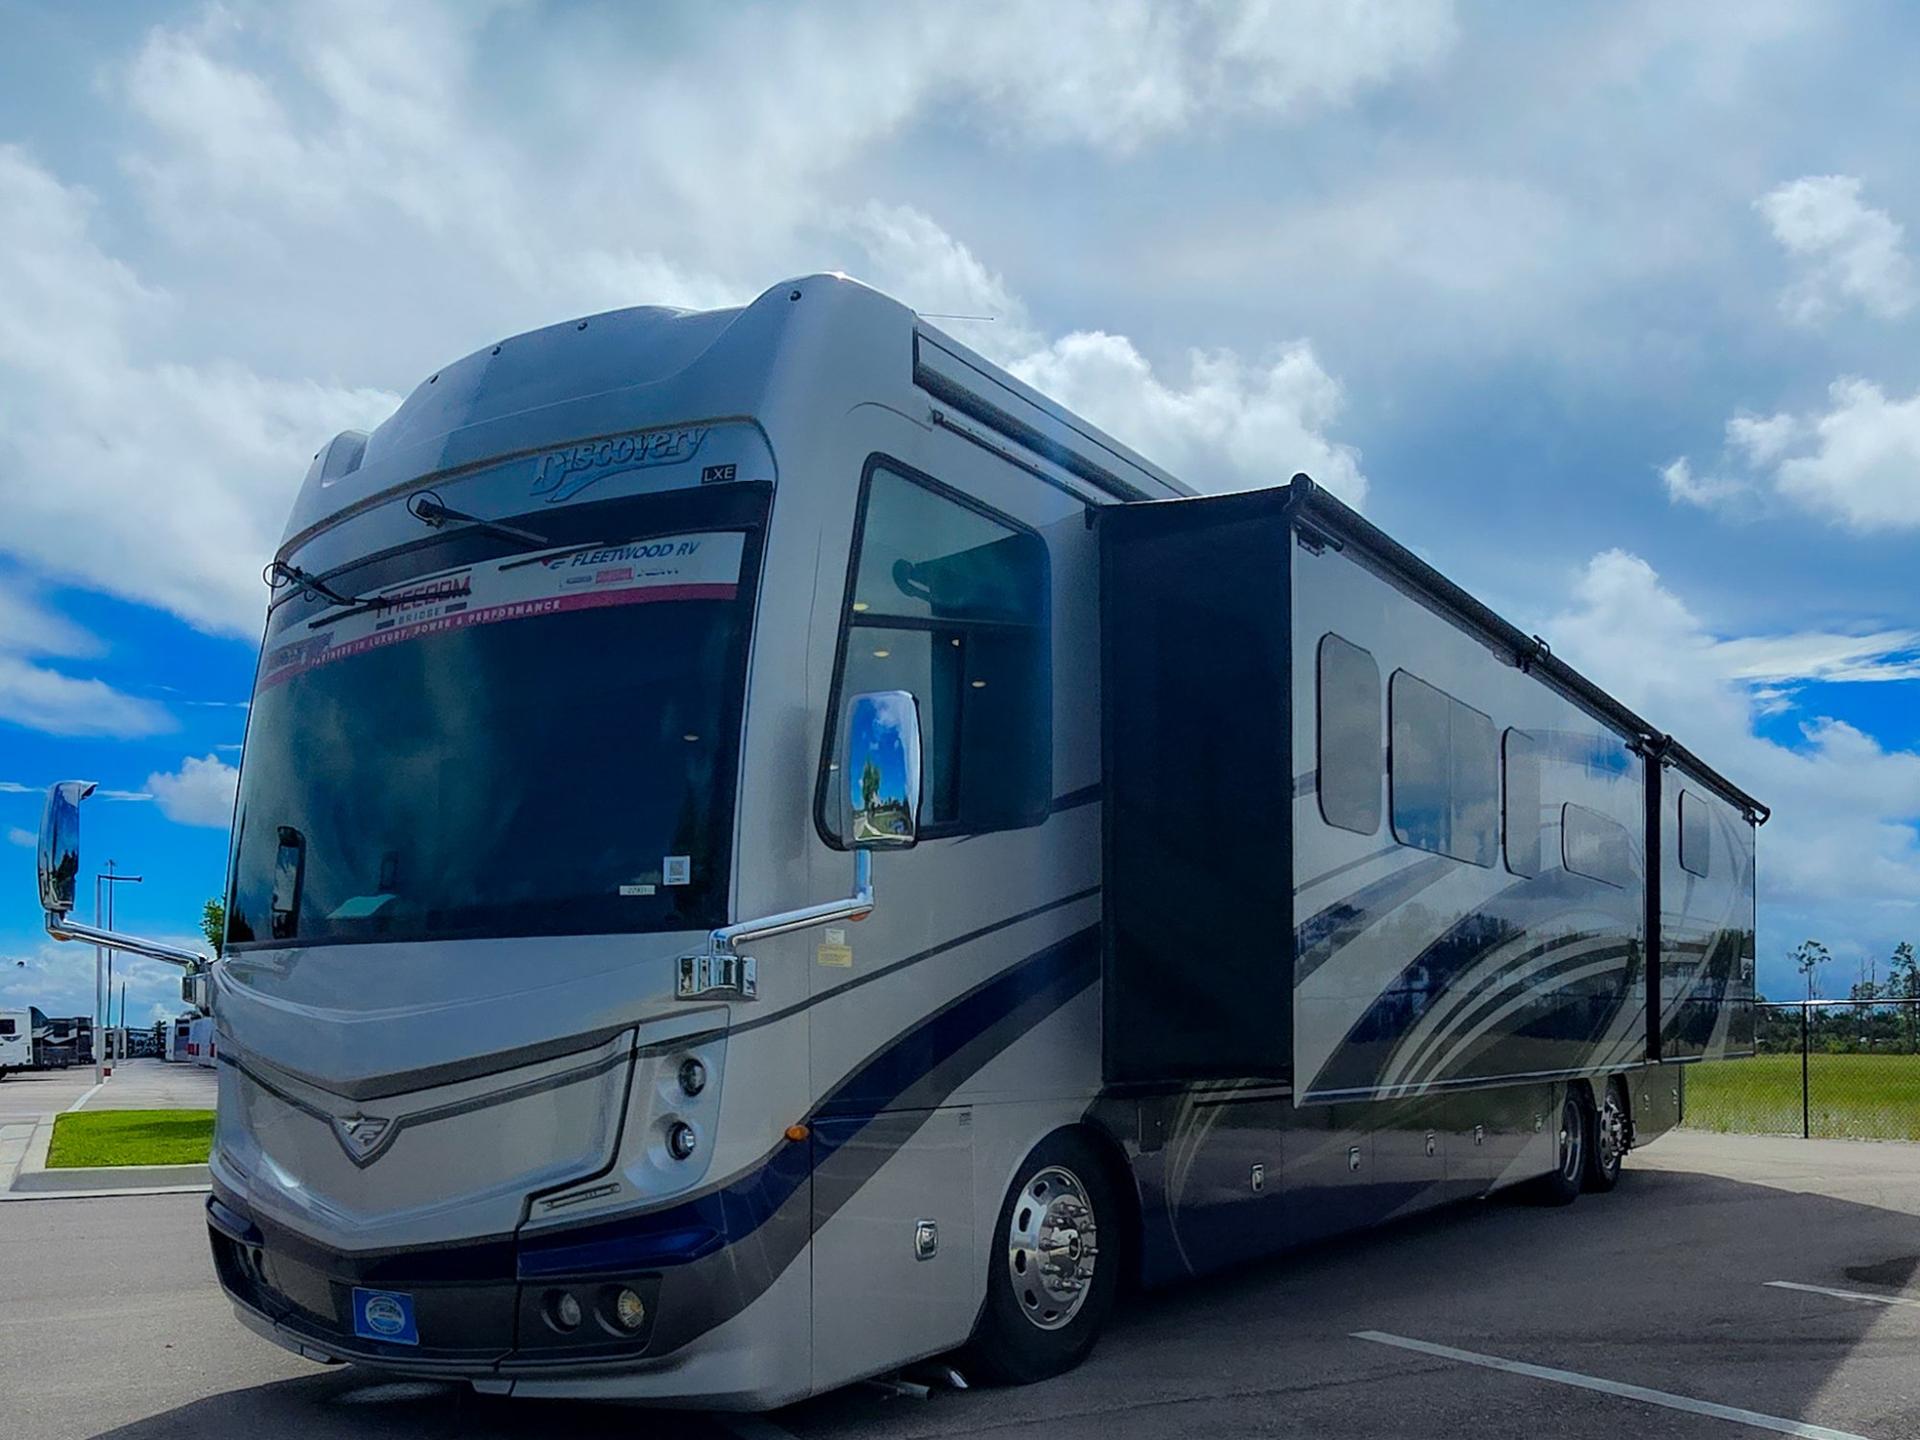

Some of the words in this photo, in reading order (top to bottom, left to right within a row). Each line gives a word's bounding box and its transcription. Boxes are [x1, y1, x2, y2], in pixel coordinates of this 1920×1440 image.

[530, 428, 711, 502] Discovery
[703, 466, 735, 482] LXE
[571, 543, 674, 567] FLEETWOOD
[676, 541, 701, 557] RV
[398, 607, 441, 625] BRIDGE
[414, 619, 451, 636] POWER
[468, 600, 561, 623] PERFORMANCE
